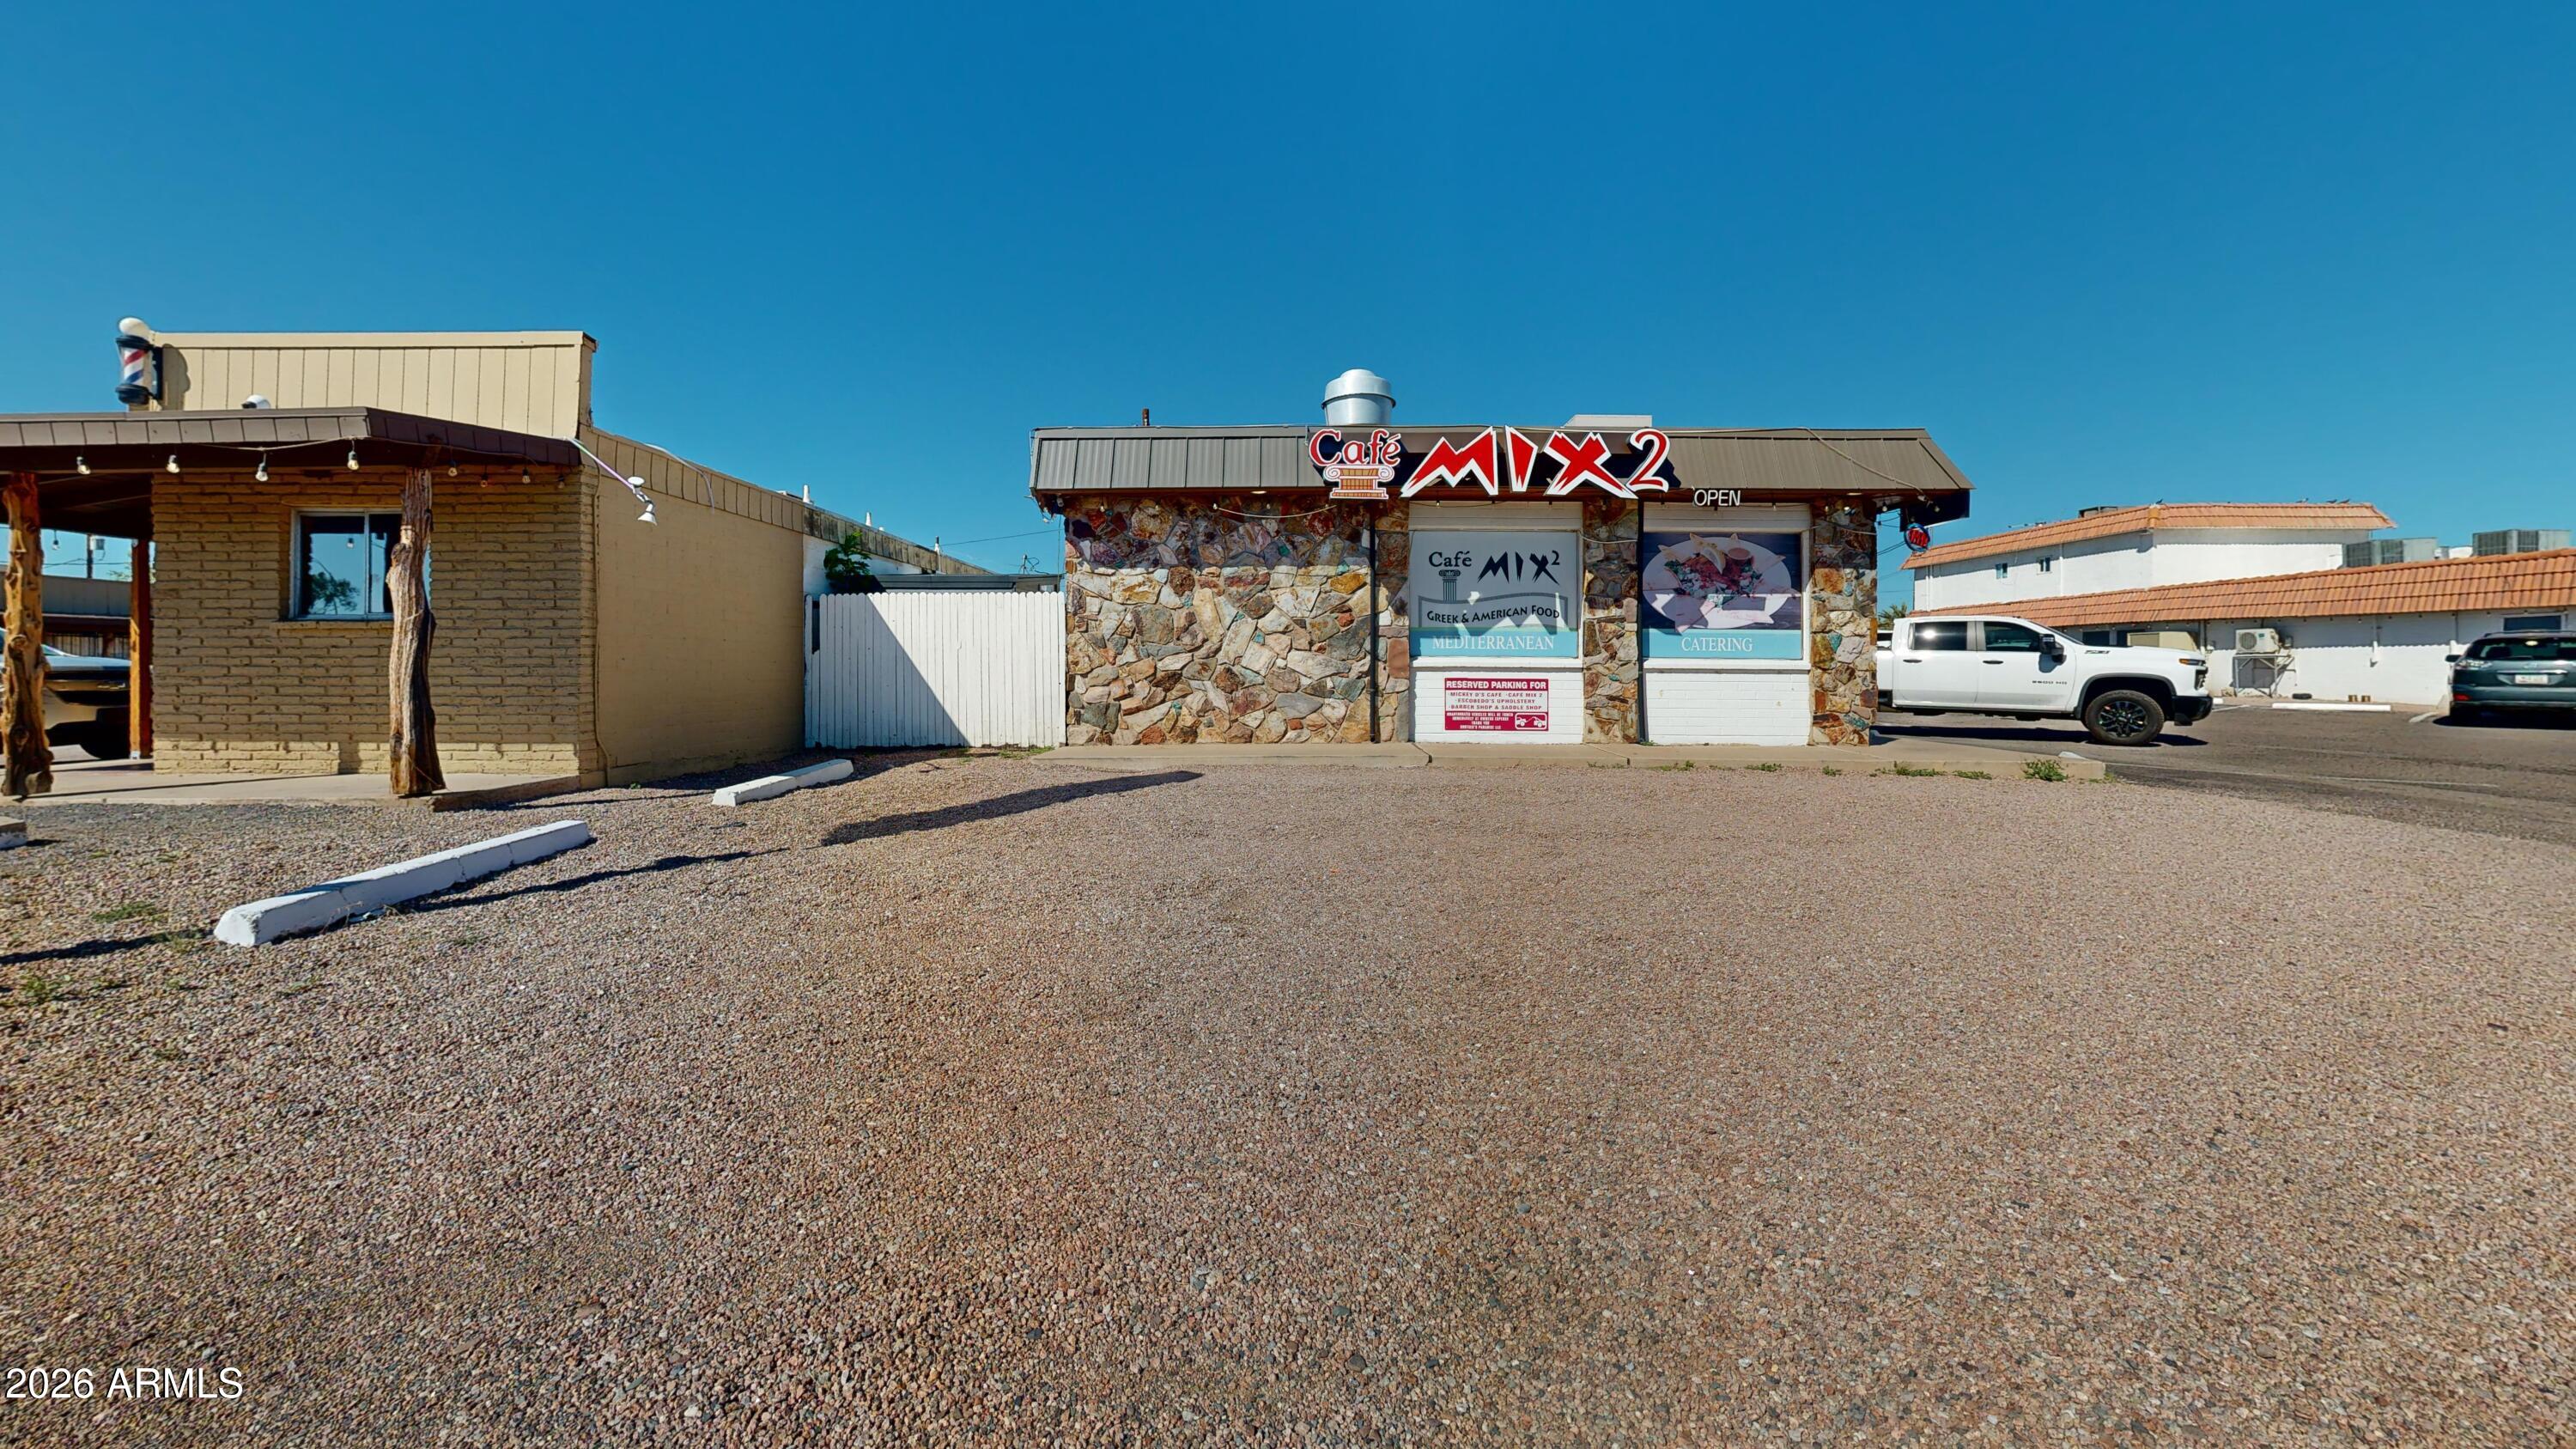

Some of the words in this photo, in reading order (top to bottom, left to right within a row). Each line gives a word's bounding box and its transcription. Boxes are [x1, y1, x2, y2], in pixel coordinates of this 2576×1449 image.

[1309, 428, 1401, 466] Café
[1694, 489, 1741, 506] OPEN
[1428, 551, 1472, 567] Café
[1427, 611, 1459, 624] GREEK
[1461, 612, 1469, 624] &
[1472, 606, 1528, 623] AMERICAN
[1531, 605, 1560, 618] FOOD
[1432, 636, 1555, 650] MEDITERRANEAN
[1681, 637, 1753, 652] CATERING
[1446, 680, 1489, 689] RESERVED
[1529, 681, 1546, 690] FOR
